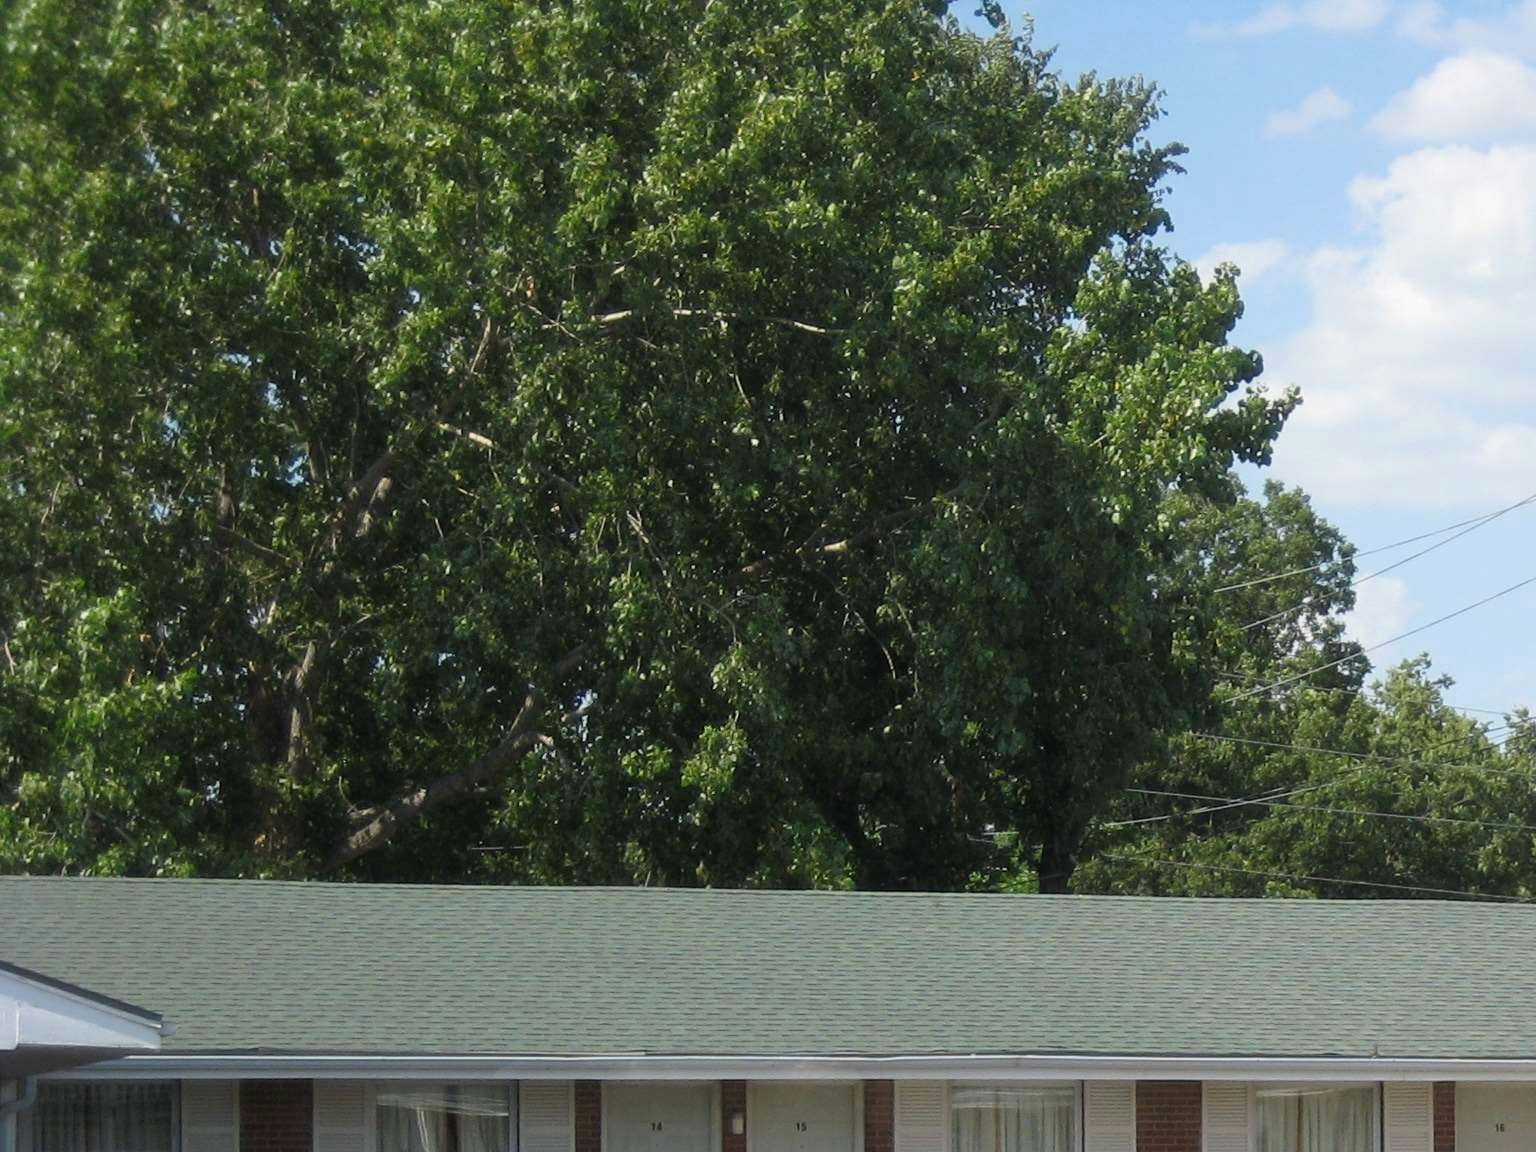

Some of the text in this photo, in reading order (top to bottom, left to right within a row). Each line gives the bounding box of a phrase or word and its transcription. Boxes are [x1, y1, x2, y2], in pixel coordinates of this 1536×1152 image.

[651, 1122, 663, 1131] 14
[796, 1122, 807, 1132] 15
[1495, 1123, 1505, 1133] 16
